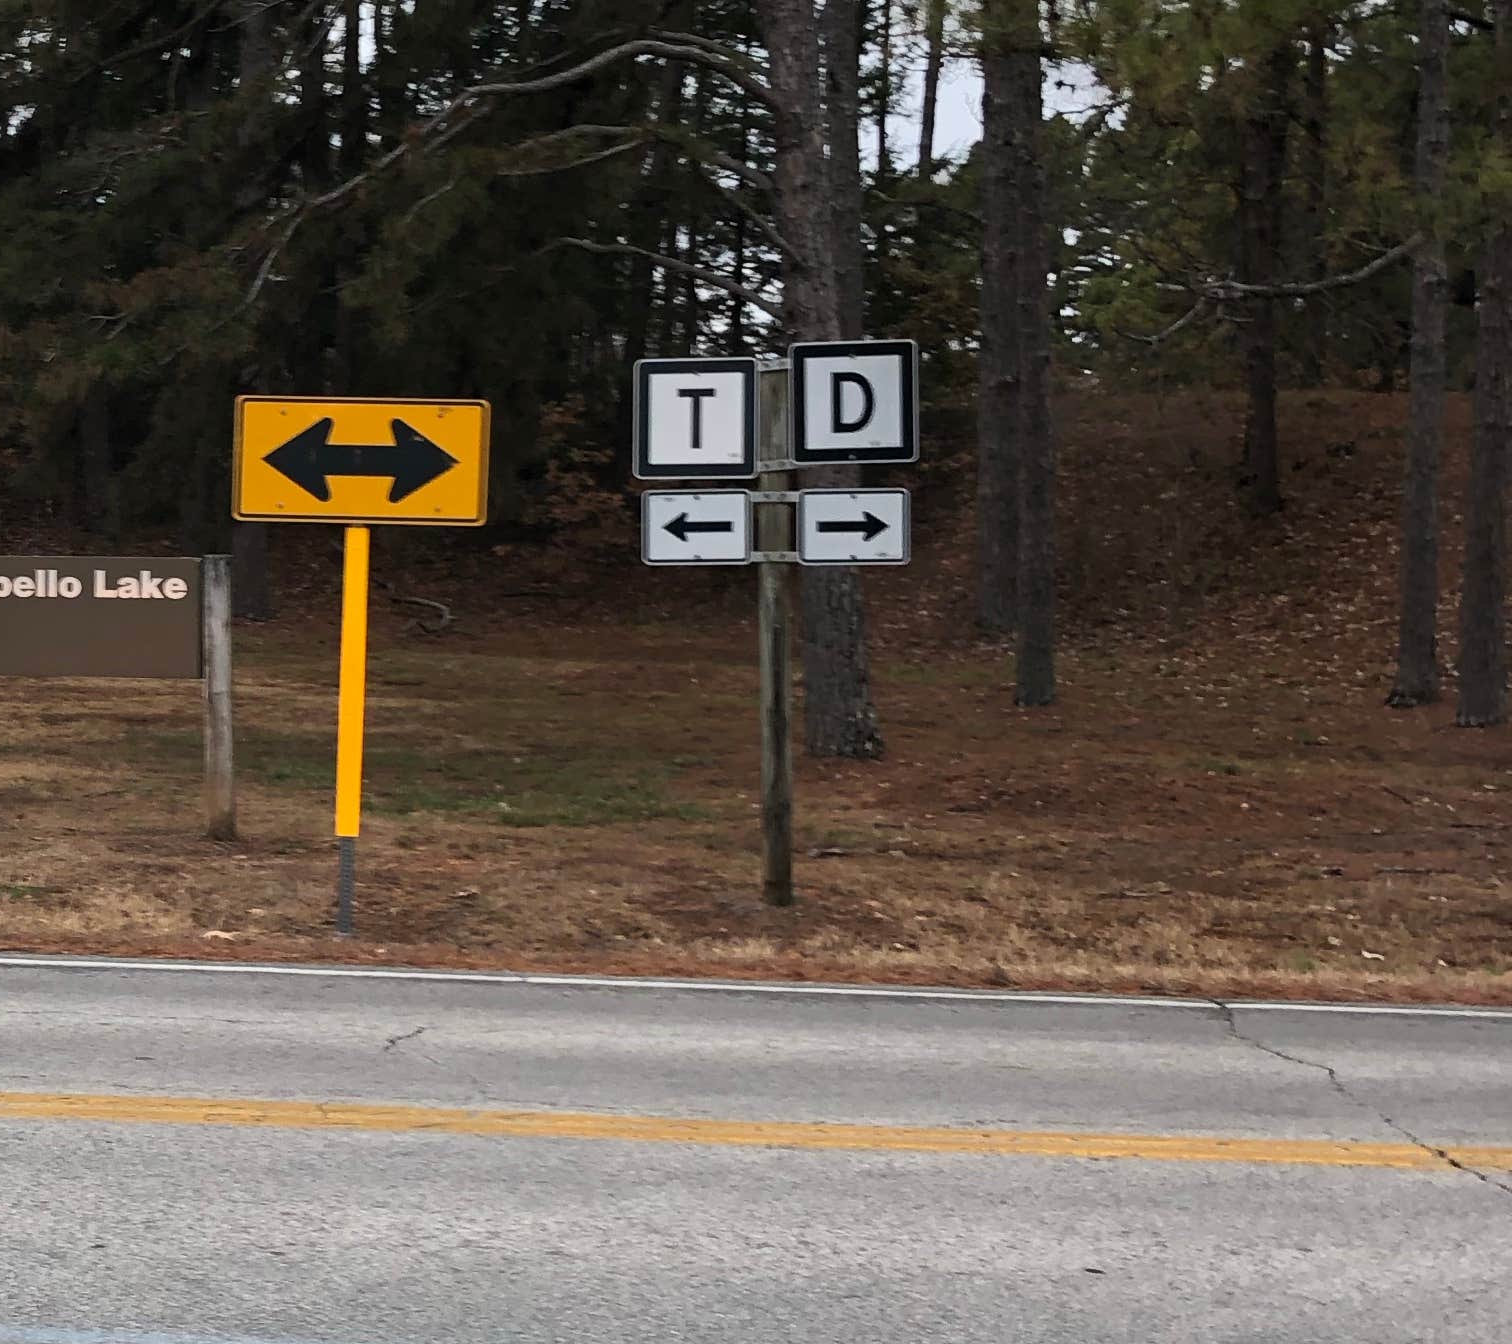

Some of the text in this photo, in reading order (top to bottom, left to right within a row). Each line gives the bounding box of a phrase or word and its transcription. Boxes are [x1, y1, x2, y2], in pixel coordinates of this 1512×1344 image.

[678, 388, 716, 449] T
[831, 371, 875, 434] D
[93, 569, 188, 600] Lake
